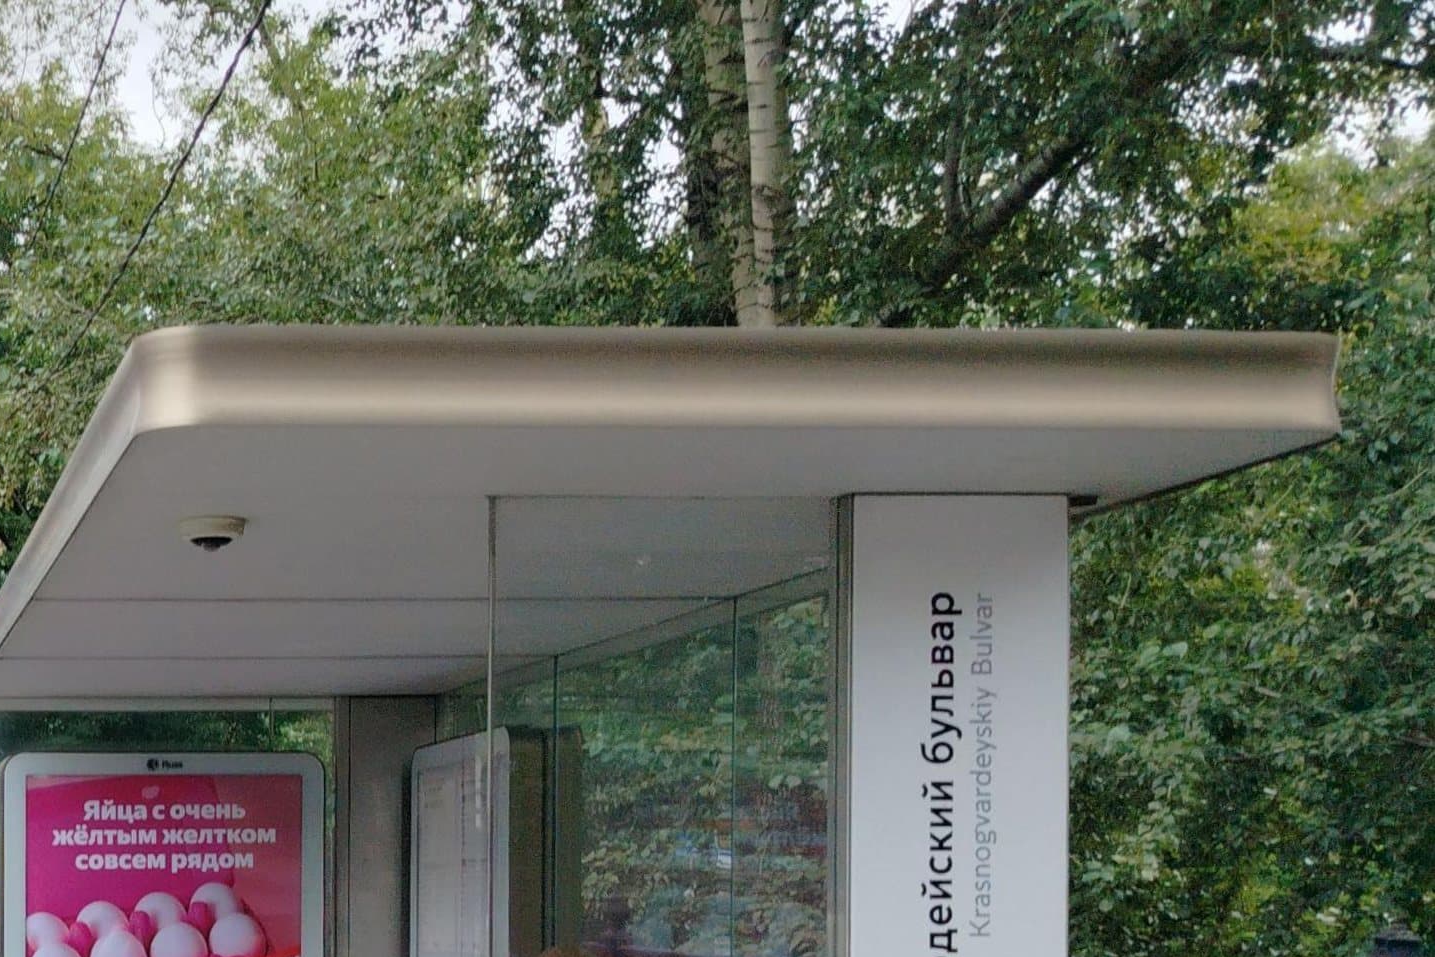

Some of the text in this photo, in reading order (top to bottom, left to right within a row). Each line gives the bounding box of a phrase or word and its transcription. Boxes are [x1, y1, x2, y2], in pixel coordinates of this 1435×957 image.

[920, 591, 963, 765] бульвар
[969, 592, 997, 937] Krasnogvardeyskiy Bulvar
[83, 799, 246, 824] Яйца с очень
[52, 824, 276, 846] жёлтым желтком
[75, 851, 254, 873] совсем рядом
